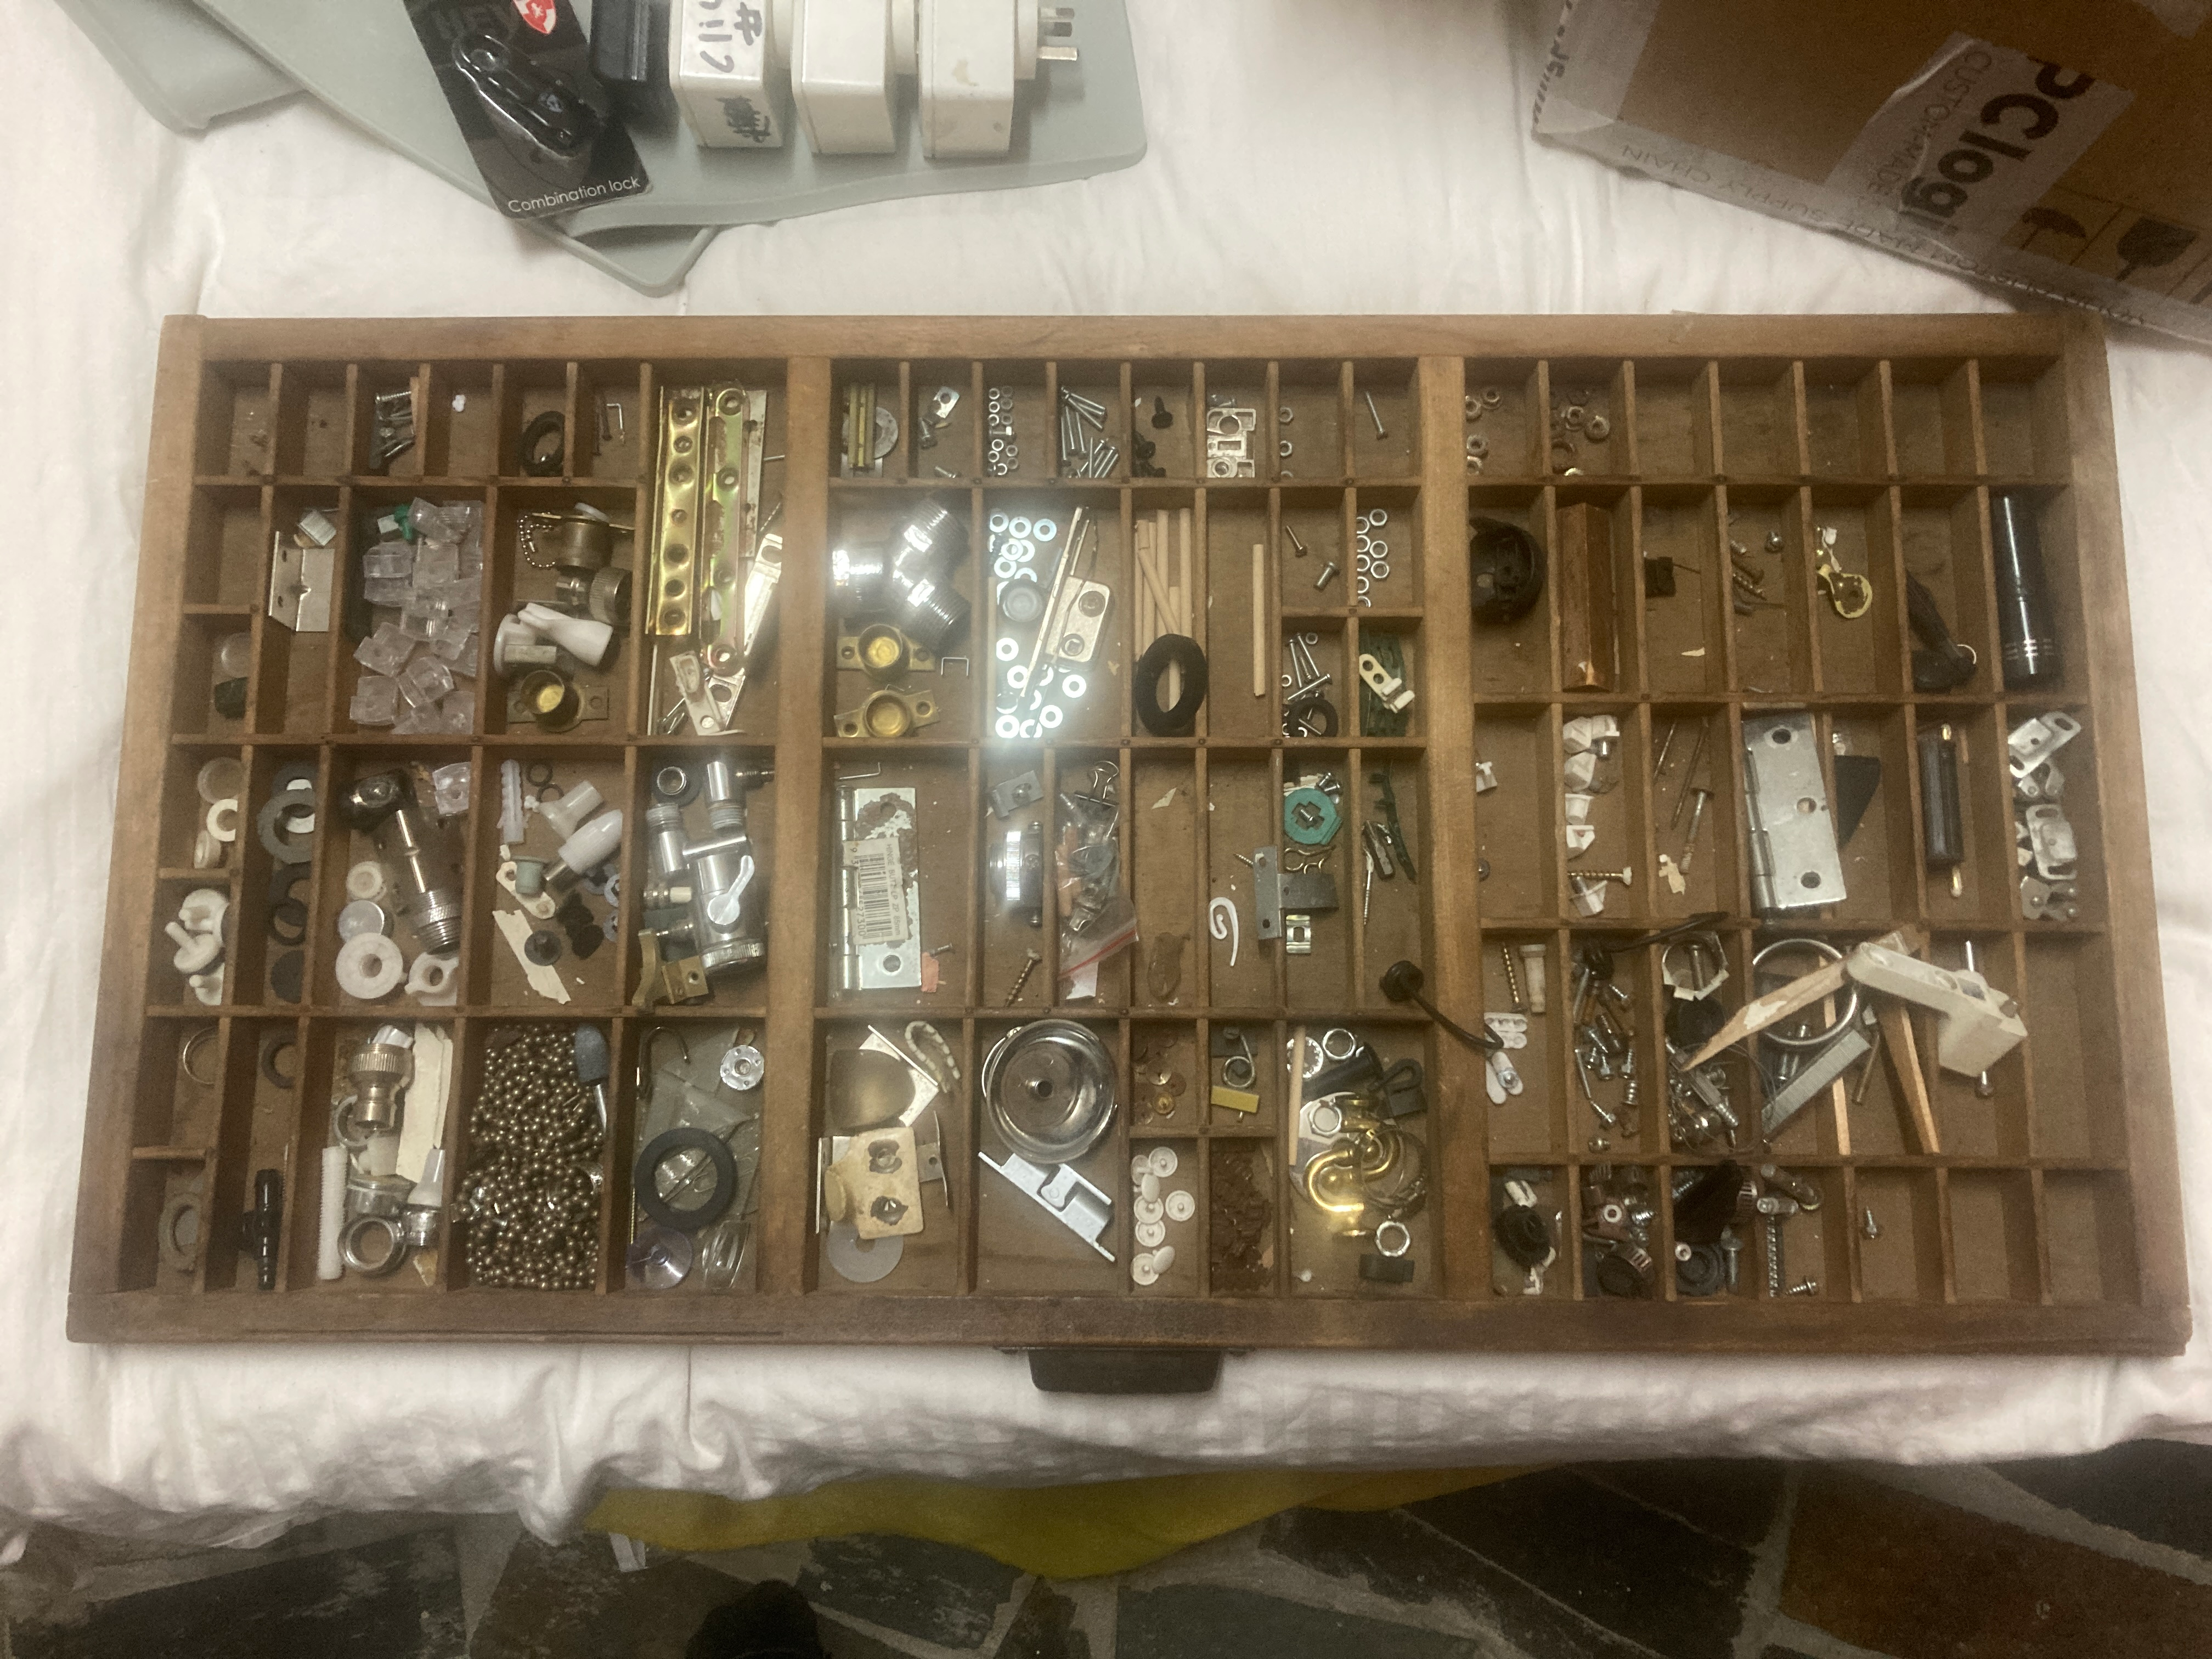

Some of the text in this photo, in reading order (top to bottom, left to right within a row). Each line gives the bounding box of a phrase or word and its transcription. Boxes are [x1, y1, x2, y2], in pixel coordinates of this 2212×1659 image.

[1622, 145, 1711, 183] CHAIN
[508, 176, 641, 213] Combination lock
[887, 844, 895, 866] HINGE
[892, 903, 899, 912] ZP
